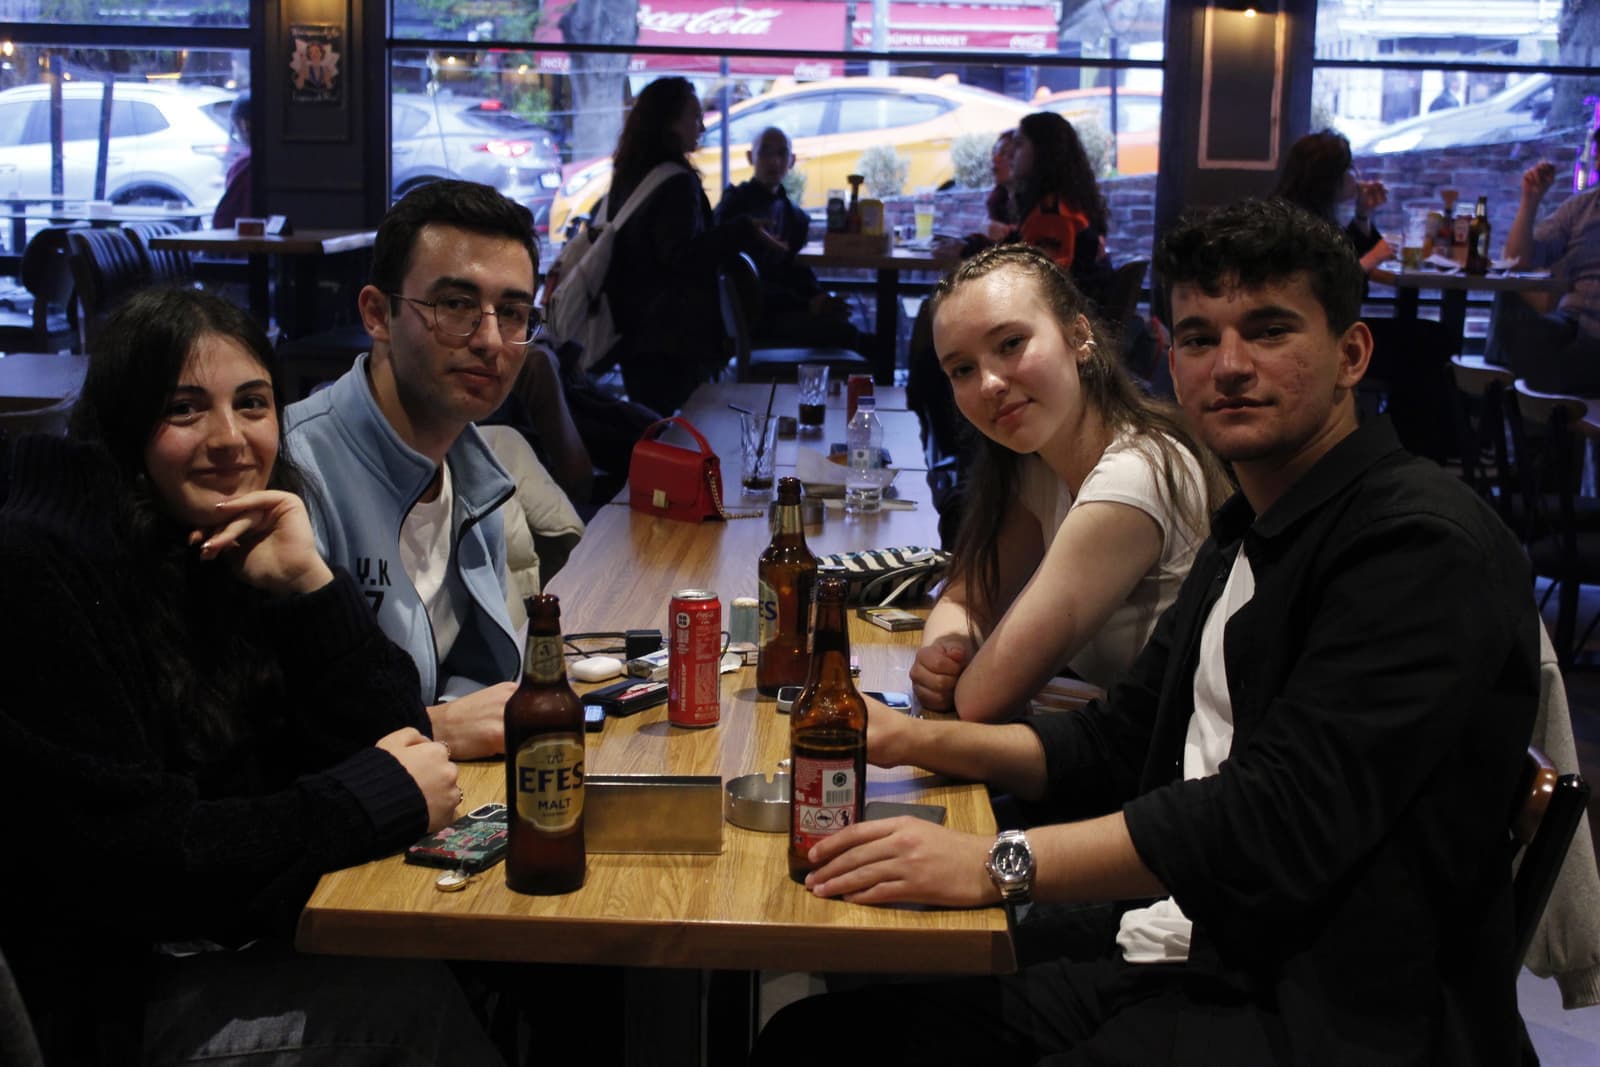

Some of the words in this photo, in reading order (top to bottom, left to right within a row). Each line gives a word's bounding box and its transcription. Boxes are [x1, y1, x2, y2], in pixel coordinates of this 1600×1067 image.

[637, 4, 783, 34] oca-Cola
[518, 761, 583, 793] EFES
[537, 797, 571, 811] MALT
